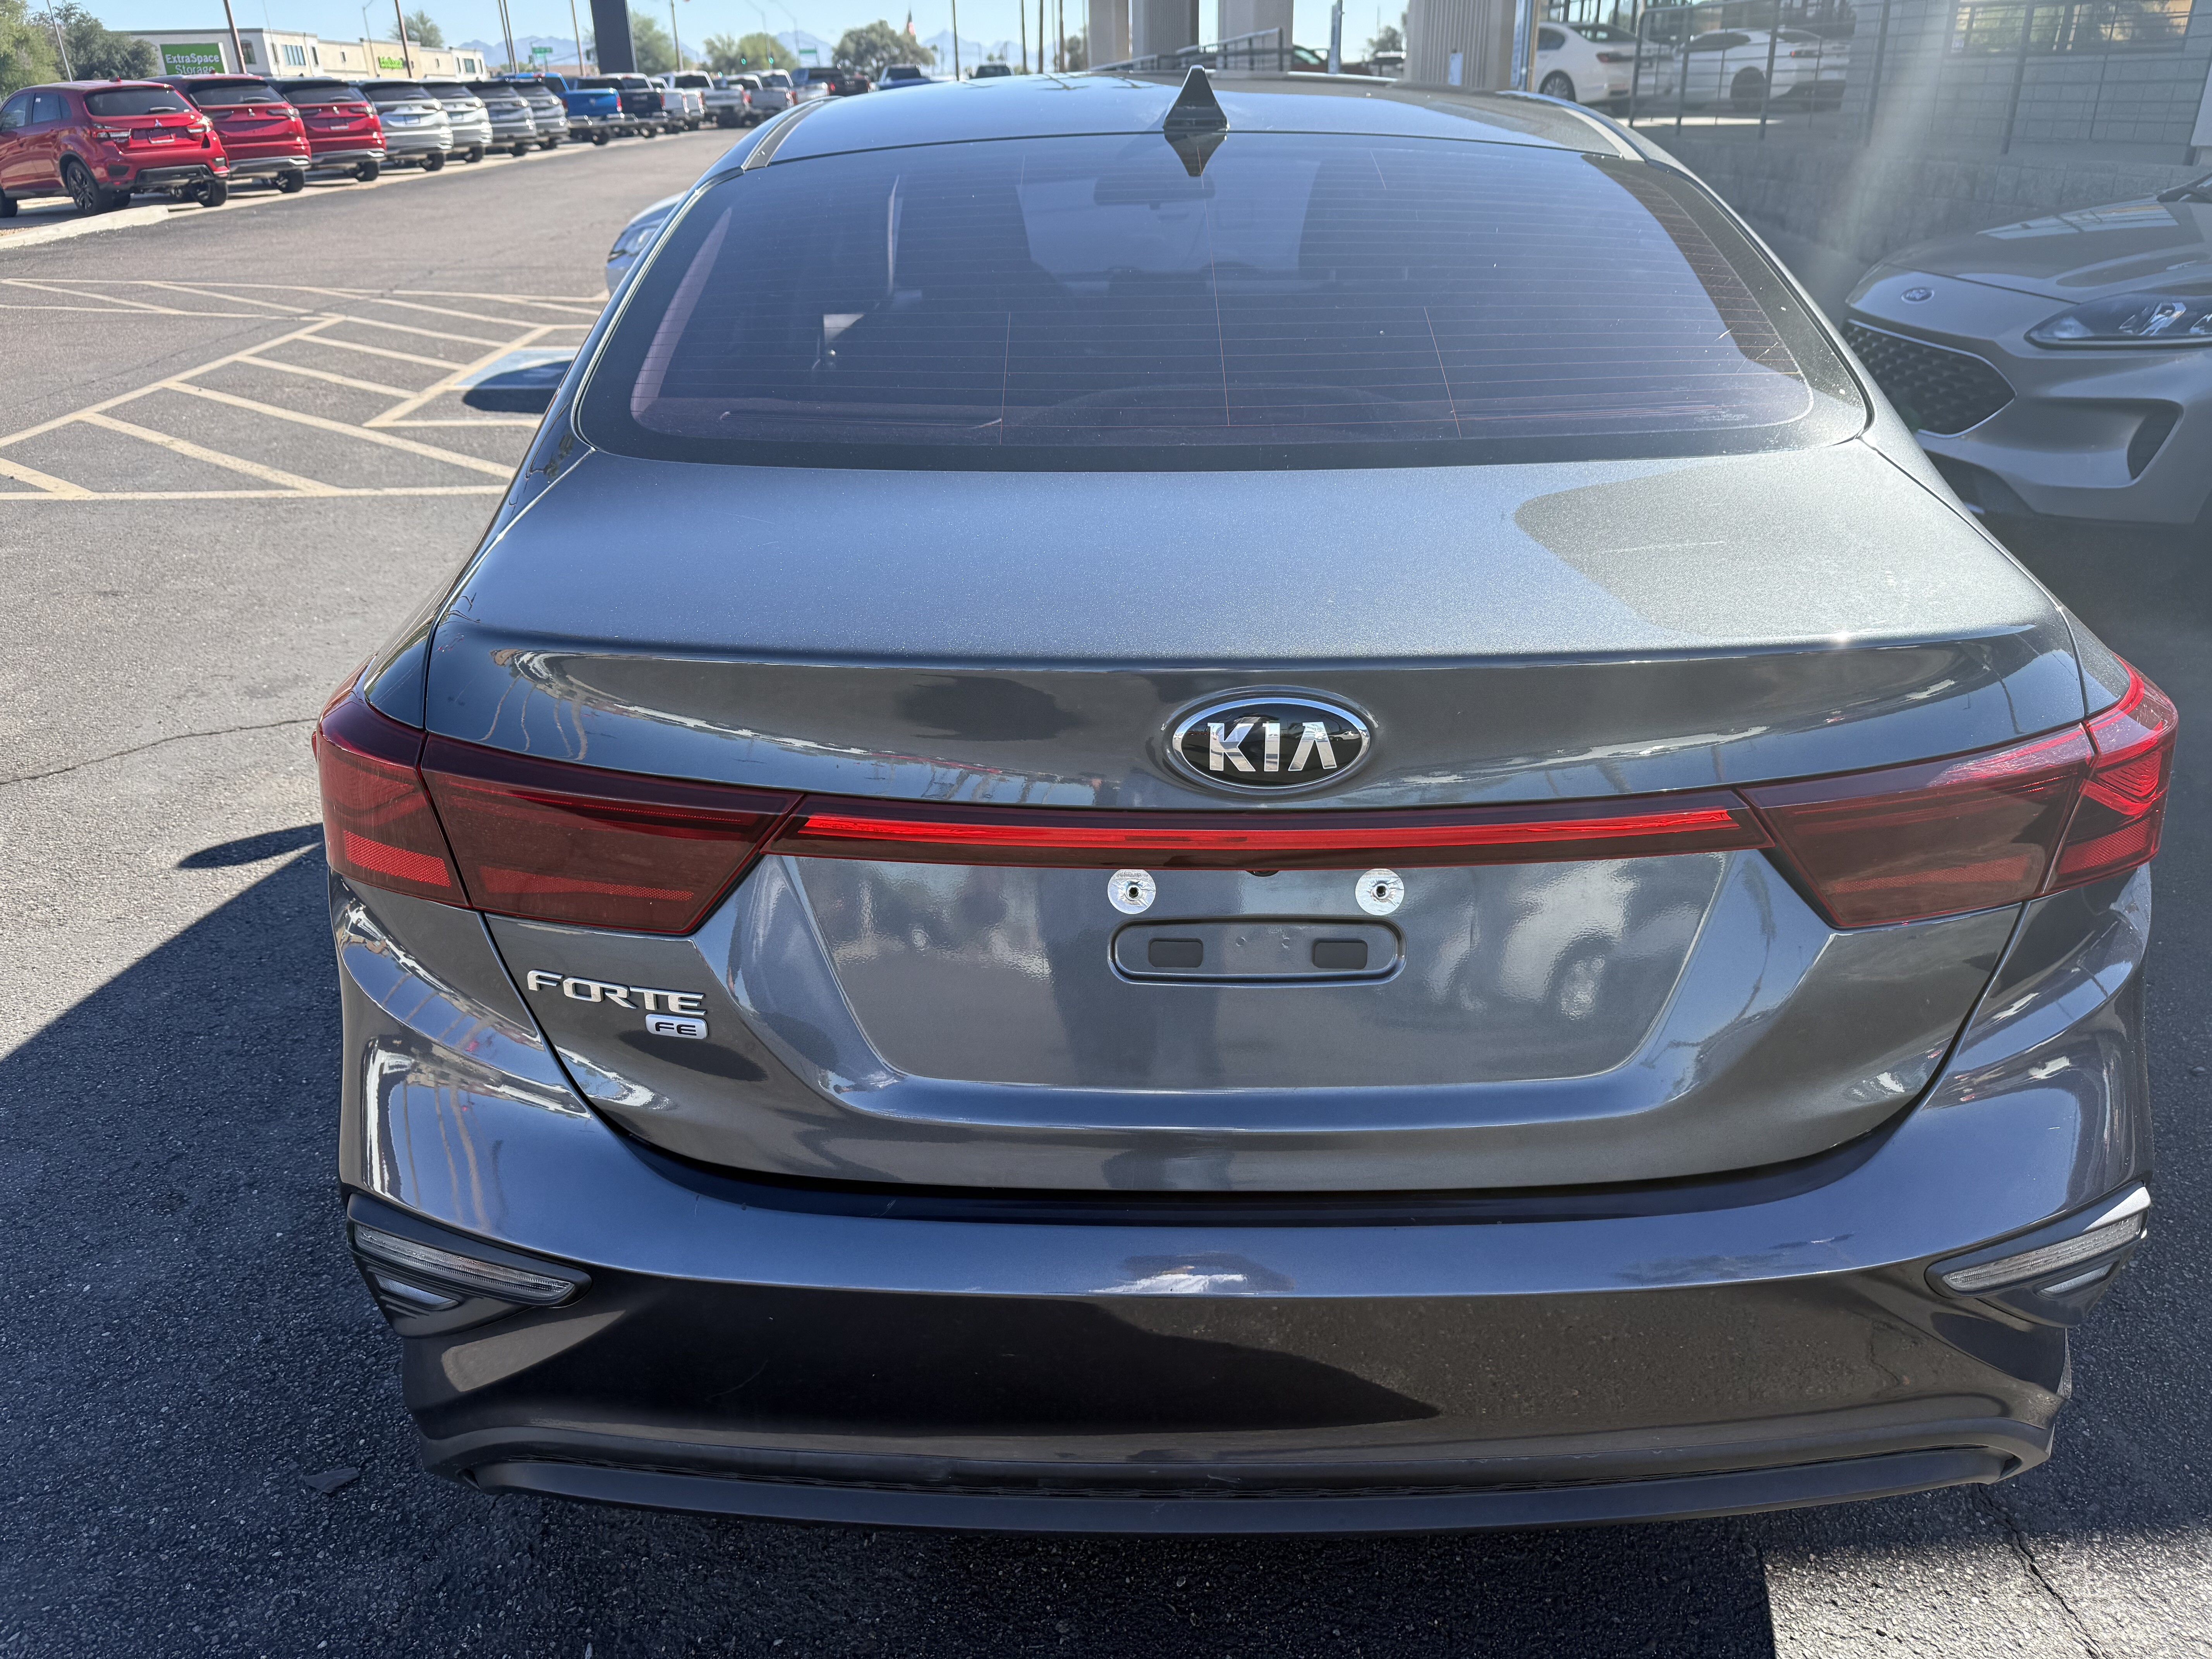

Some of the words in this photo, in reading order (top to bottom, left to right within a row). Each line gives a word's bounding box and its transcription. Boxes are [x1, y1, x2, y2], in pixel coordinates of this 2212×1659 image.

[1207, 721, 1337, 772] KIA
[527, 969, 708, 1016] FORTE
[654, 1021, 697, 1036] FE
